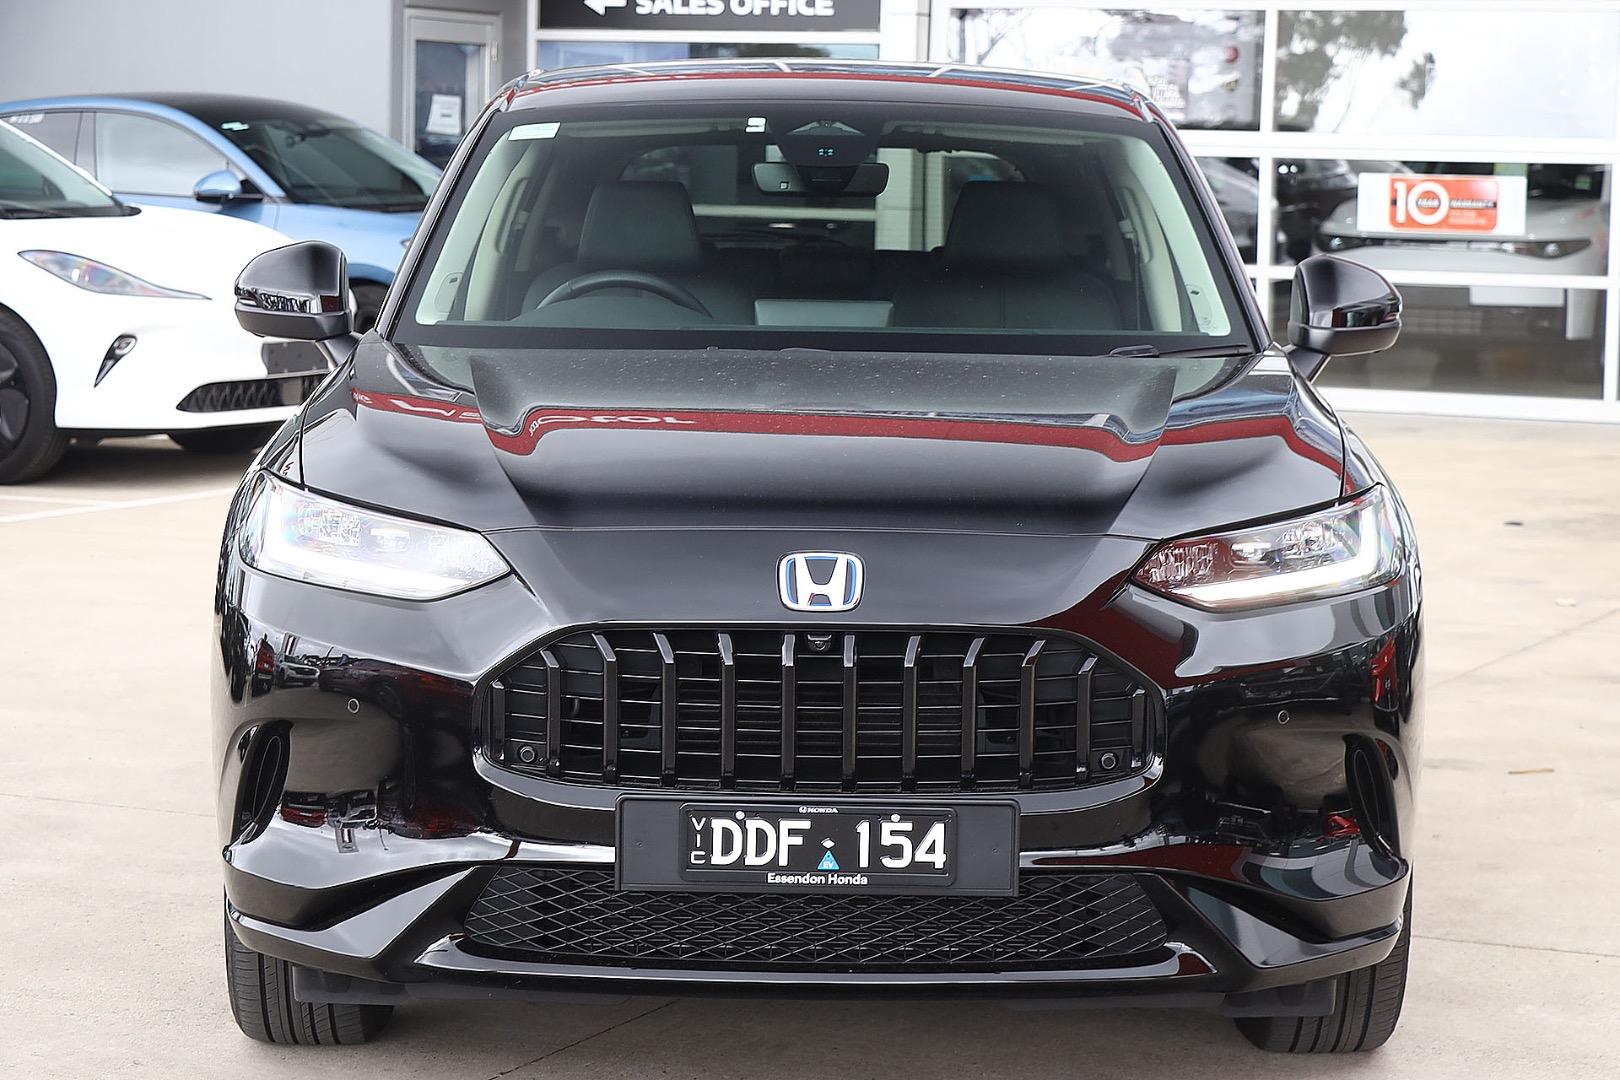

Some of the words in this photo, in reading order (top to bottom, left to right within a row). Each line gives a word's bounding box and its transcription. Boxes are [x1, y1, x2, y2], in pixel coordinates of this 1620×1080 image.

[635, 0, 725, 16] SALES
[729, 0, 835, 16] OFFICE
[1393, 181, 1449, 225] 10
[691, 817, 706, 864] VIC
[711, 818, 811, 867] DDF
[856, 820, 947, 869] 154
[767, 872, 826, 885] Essendon
[828, 873, 868, 886] Honda
